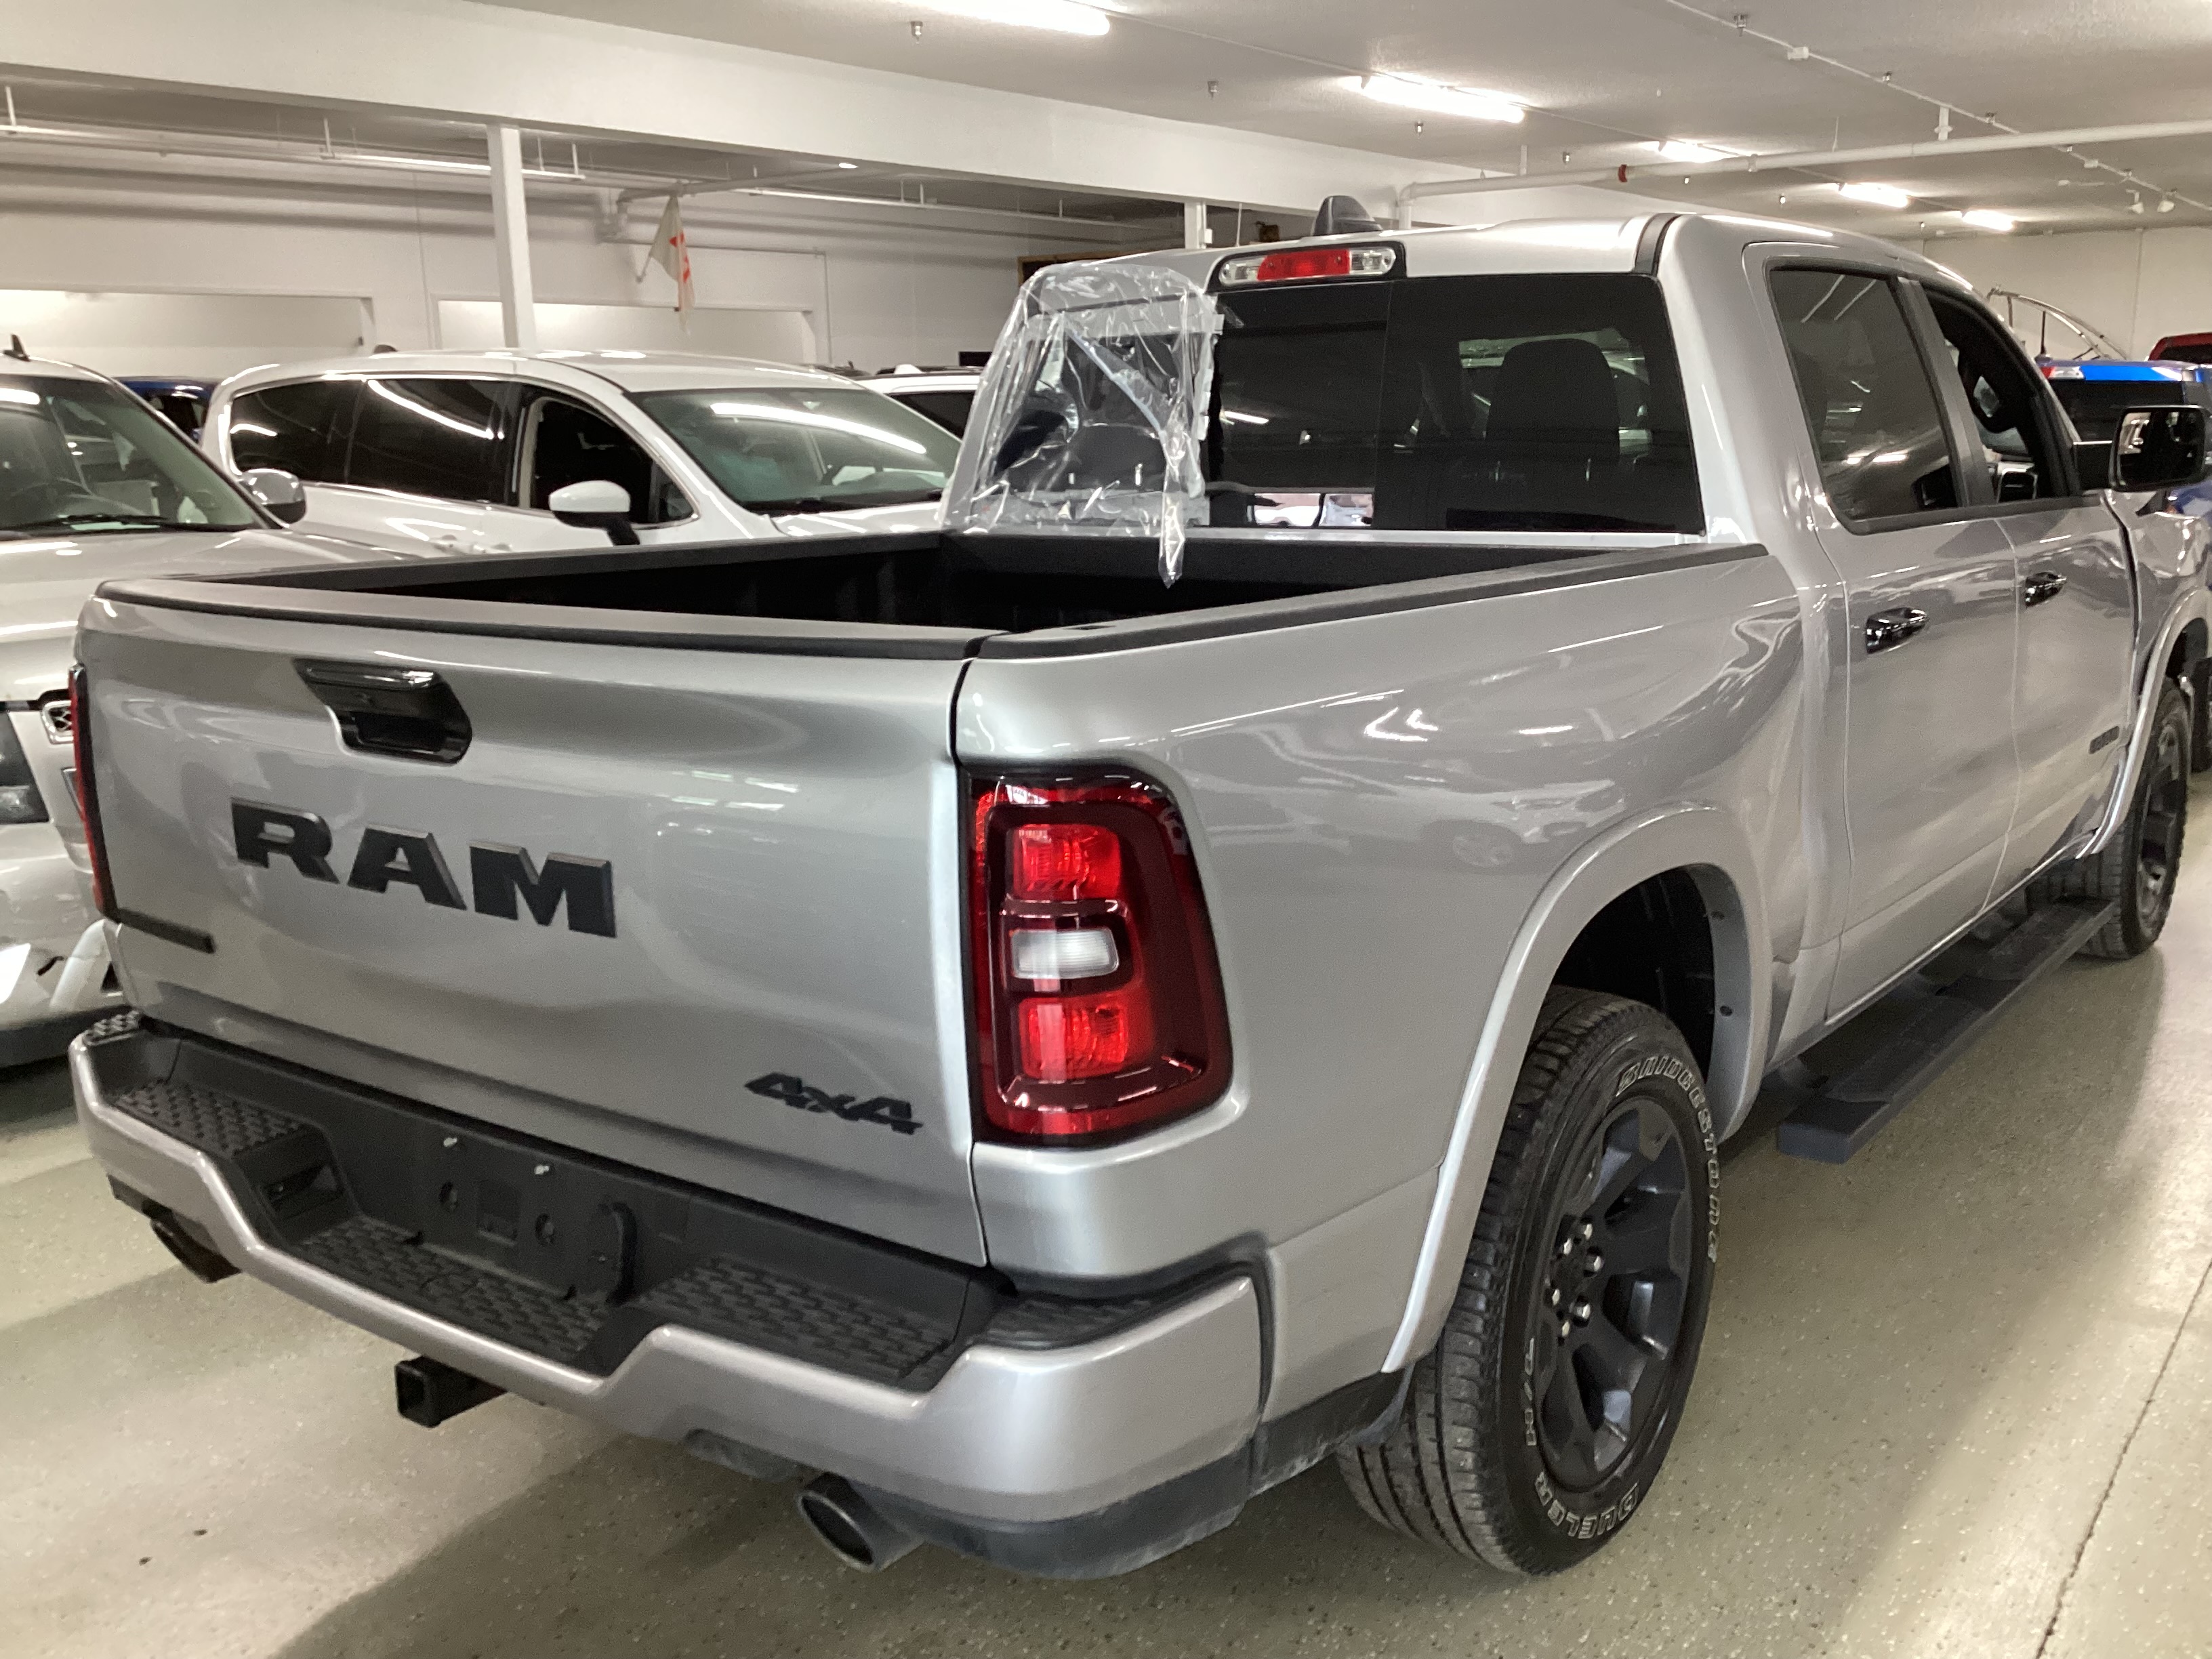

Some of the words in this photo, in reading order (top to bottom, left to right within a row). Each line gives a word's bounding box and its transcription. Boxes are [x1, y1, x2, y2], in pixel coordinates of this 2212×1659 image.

[231, 797, 617, 939] RAM
[1616, 1055, 1720, 1263] BRIDGESTONE
[1534, 1471, 1639, 1539] DUELER
